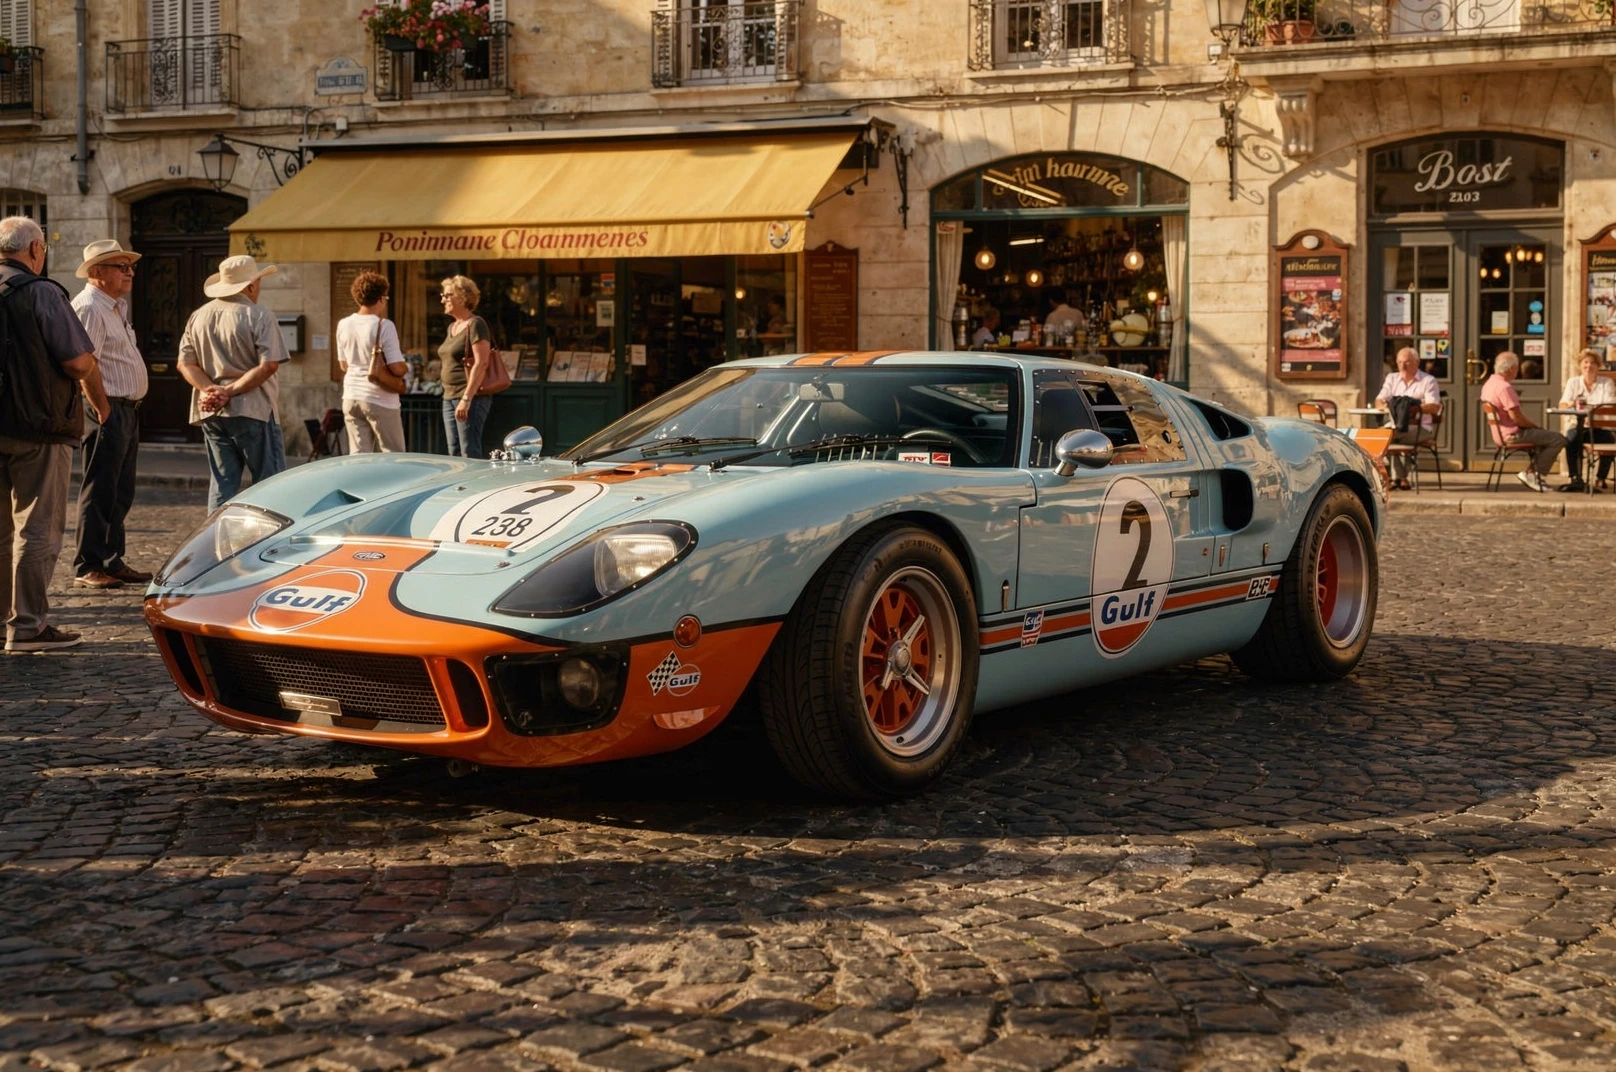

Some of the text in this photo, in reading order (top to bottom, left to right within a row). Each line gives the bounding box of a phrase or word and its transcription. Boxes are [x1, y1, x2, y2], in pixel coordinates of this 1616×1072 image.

[1414, 150, 1512, 192] Bost
[500, 484, 576, 515] 2
[471, 516, 533, 538] 238
[1119, 500, 1152, 591] 2
[265, 587, 352, 612] Gulf
[1101, 590, 1157, 625] Gulf
[669, 674, 700, 687] Gulf
